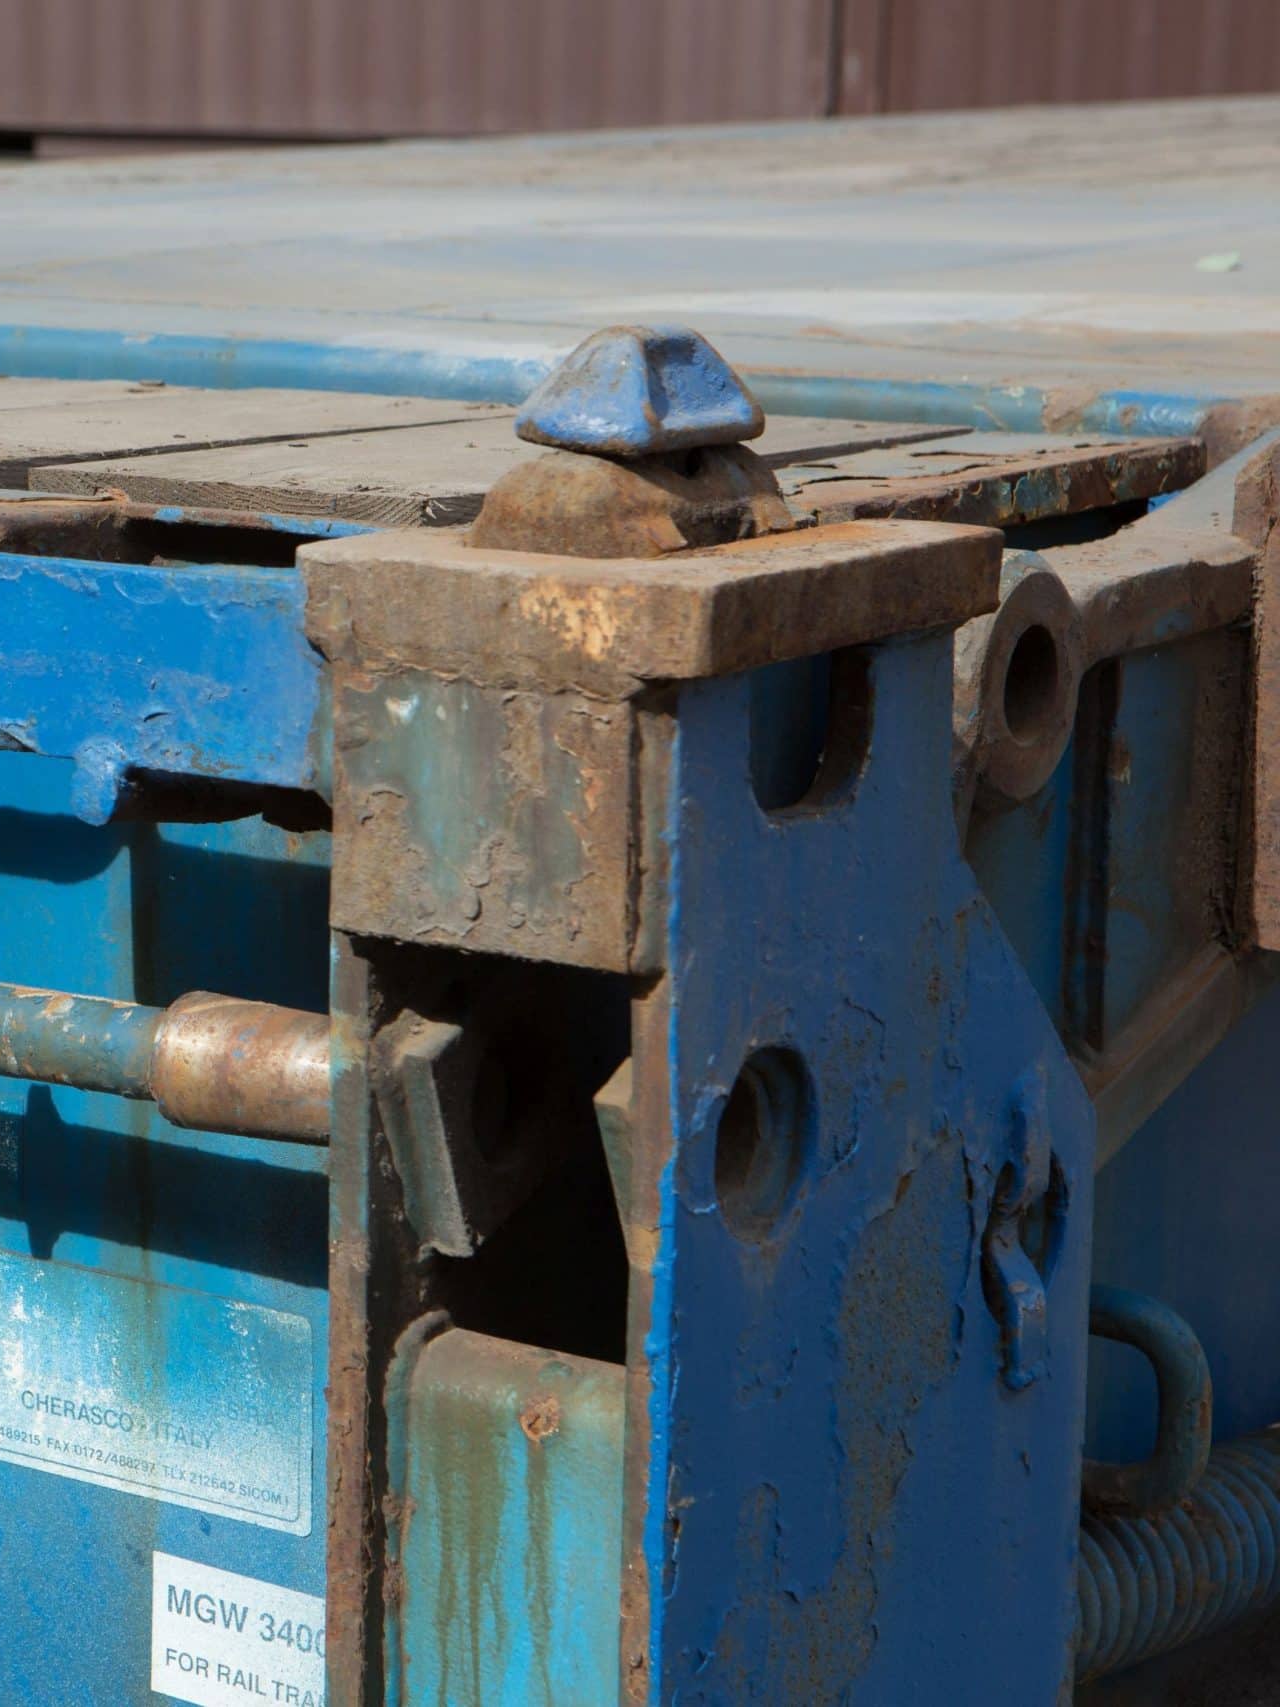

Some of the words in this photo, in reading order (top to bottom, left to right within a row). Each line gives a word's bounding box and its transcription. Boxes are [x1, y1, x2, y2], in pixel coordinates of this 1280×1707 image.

[21, 1389, 134, 1433] CHERASCO
[154, 1411, 215, 1450] ITALY
[166, 1584, 249, 1633] MGW
[165, 1647, 210, 1678] FOR
[216, 1663, 267, 1696] RAIL
[270, 1679, 325, 1707] TRA
